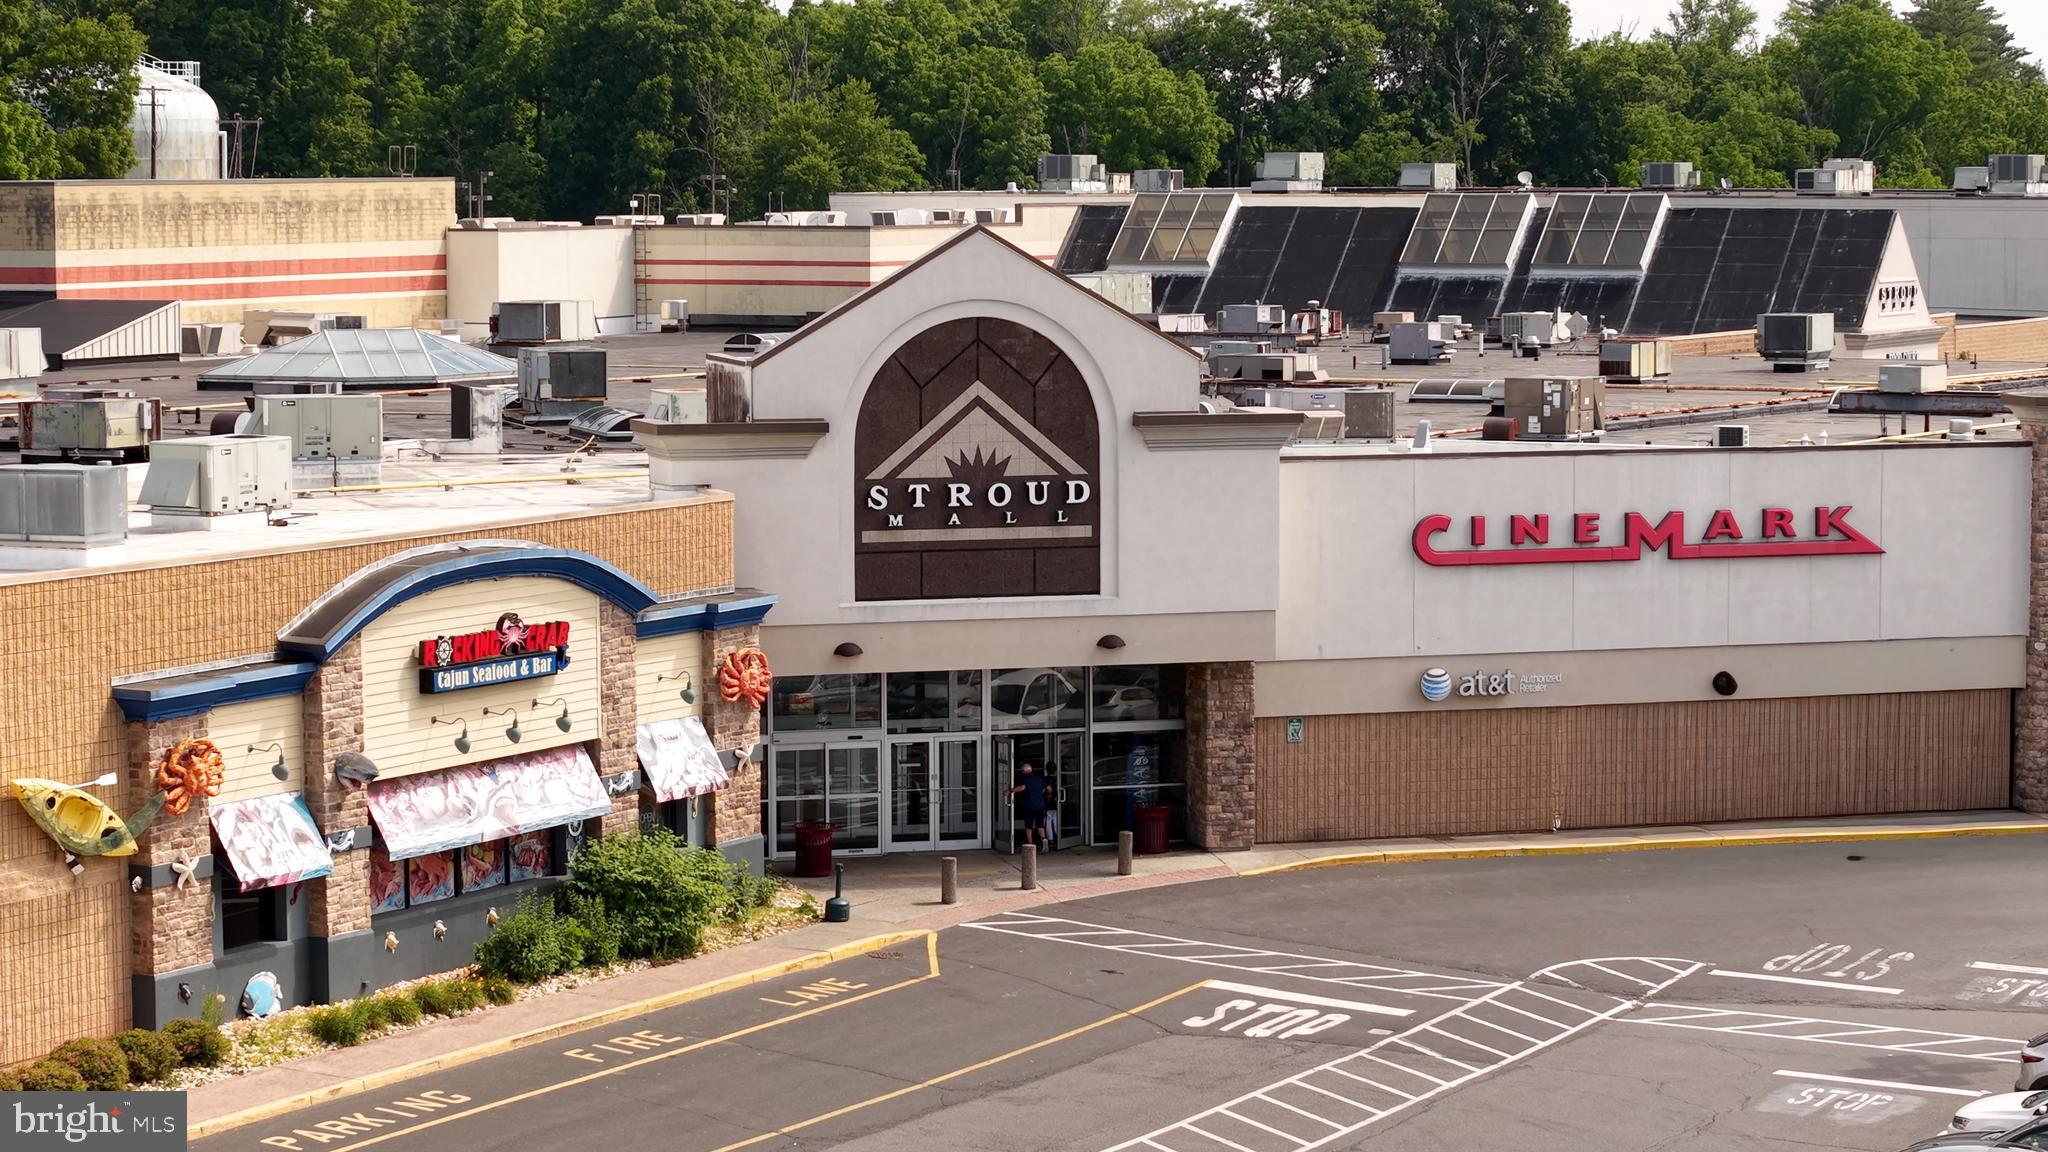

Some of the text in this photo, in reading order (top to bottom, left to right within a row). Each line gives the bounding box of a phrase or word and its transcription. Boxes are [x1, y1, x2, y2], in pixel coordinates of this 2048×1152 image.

[867, 480, 1091, 510] STROUD
[888, 510, 1069, 527] MALL
[1412, 505, 1886, 566] CINEMARK
[525, 620, 570, 651] CRAB
[437, 656, 553, 689] Cajun Seafood & Bar
[1458, 669, 1517, 697] at&t
[1519, 672, 1562, 684] Authorized
[1519, 682, 1548, 693] Retailer
[1762, 942, 1915, 981] STOP
[1986, 978, 2048, 998] STO
[1182, 999, 1351, 1039] STOP
[260, 977, 868, 1151] PARKING FIRE LANE
[1787, 1087, 1894, 1112] STOP
